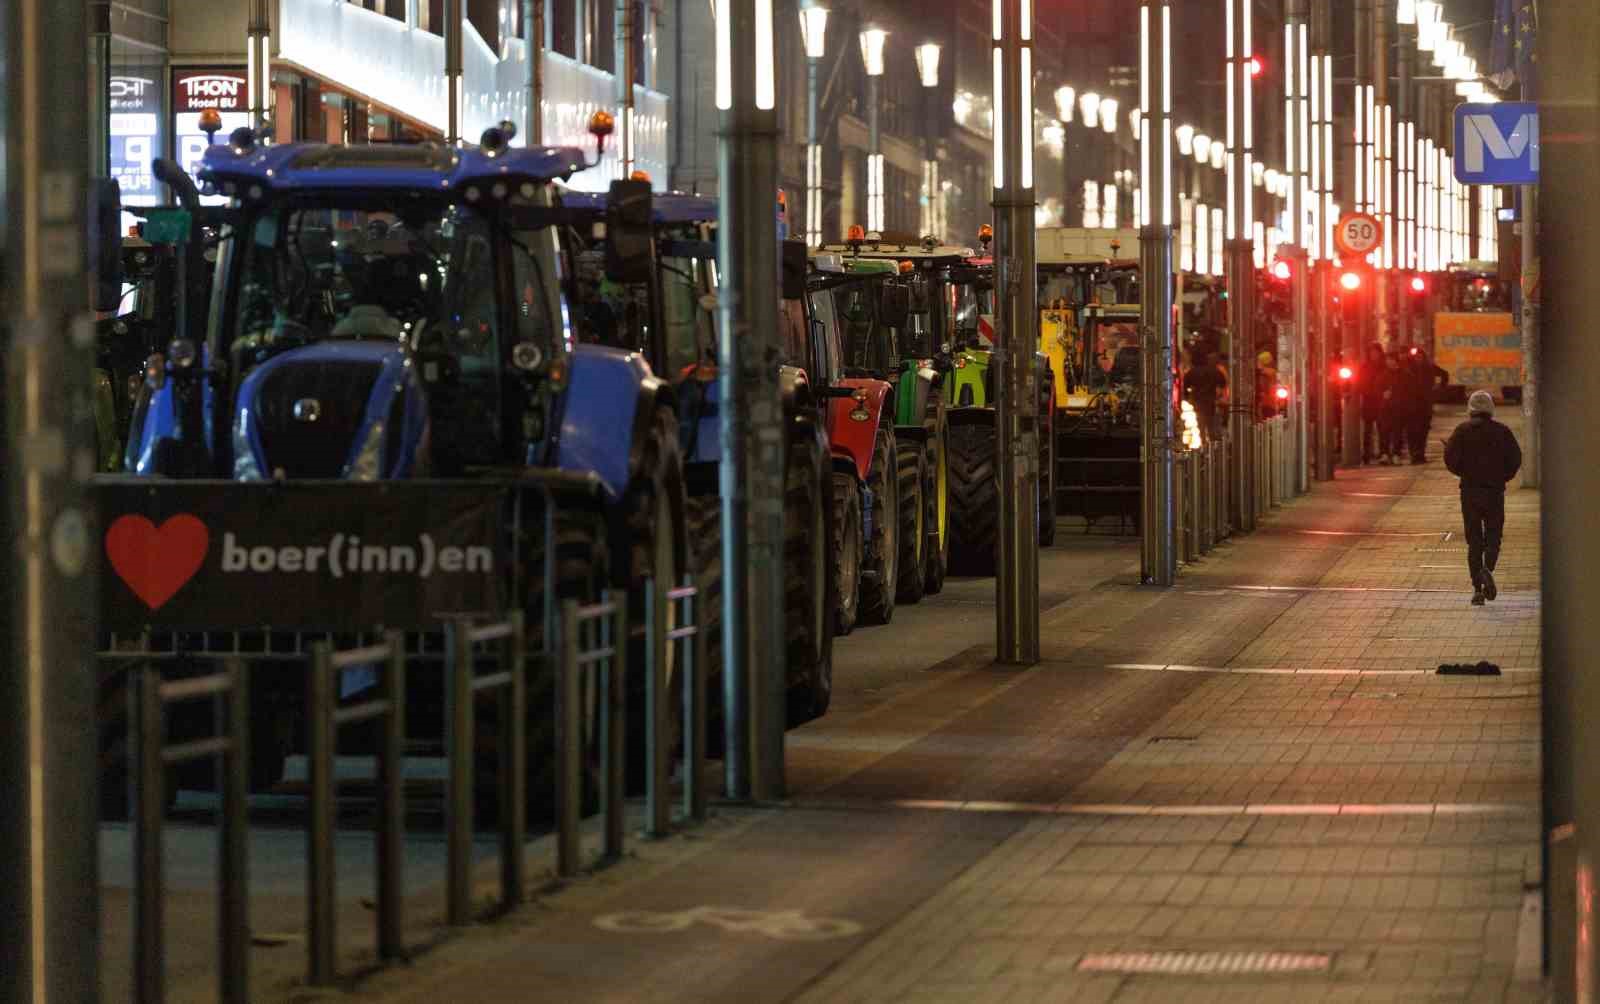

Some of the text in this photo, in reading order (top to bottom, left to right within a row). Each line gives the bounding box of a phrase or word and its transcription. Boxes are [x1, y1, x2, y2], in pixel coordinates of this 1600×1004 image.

[179, 75, 246, 97] THON
[188, 98, 237, 108] Hotel EU
[1463, 113, 1539, 173] M
[1348, 223, 1372, 240] 50
[221, 531, 493, 578] boer(inn)en
